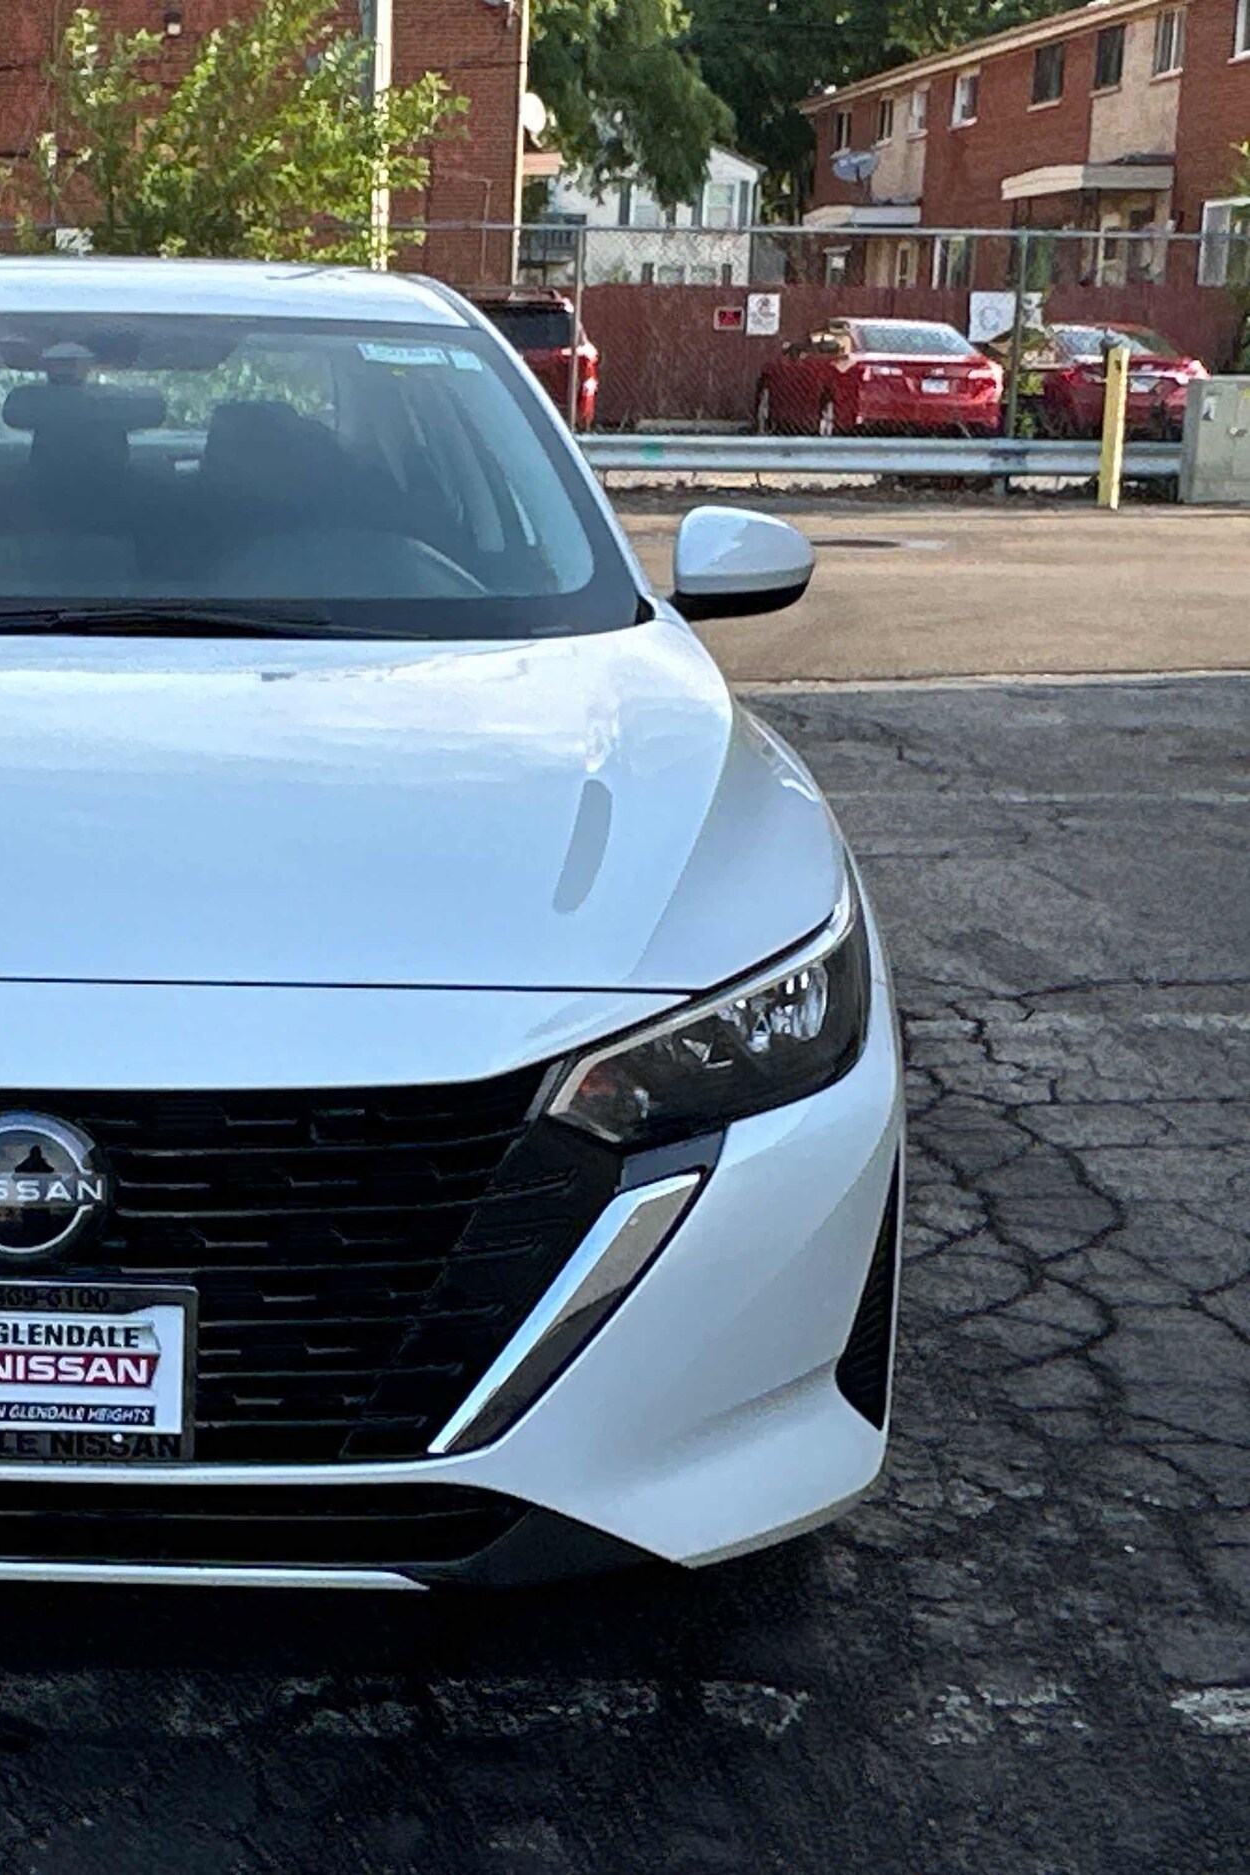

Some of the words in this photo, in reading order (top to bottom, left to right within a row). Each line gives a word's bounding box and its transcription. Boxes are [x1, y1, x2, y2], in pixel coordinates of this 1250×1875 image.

[9, 1403, 85, 1421] GLENDALE
[87, 1407, 150, 1422] HEIGHTS
[51, 1433, 181, 1458] NISSAN
